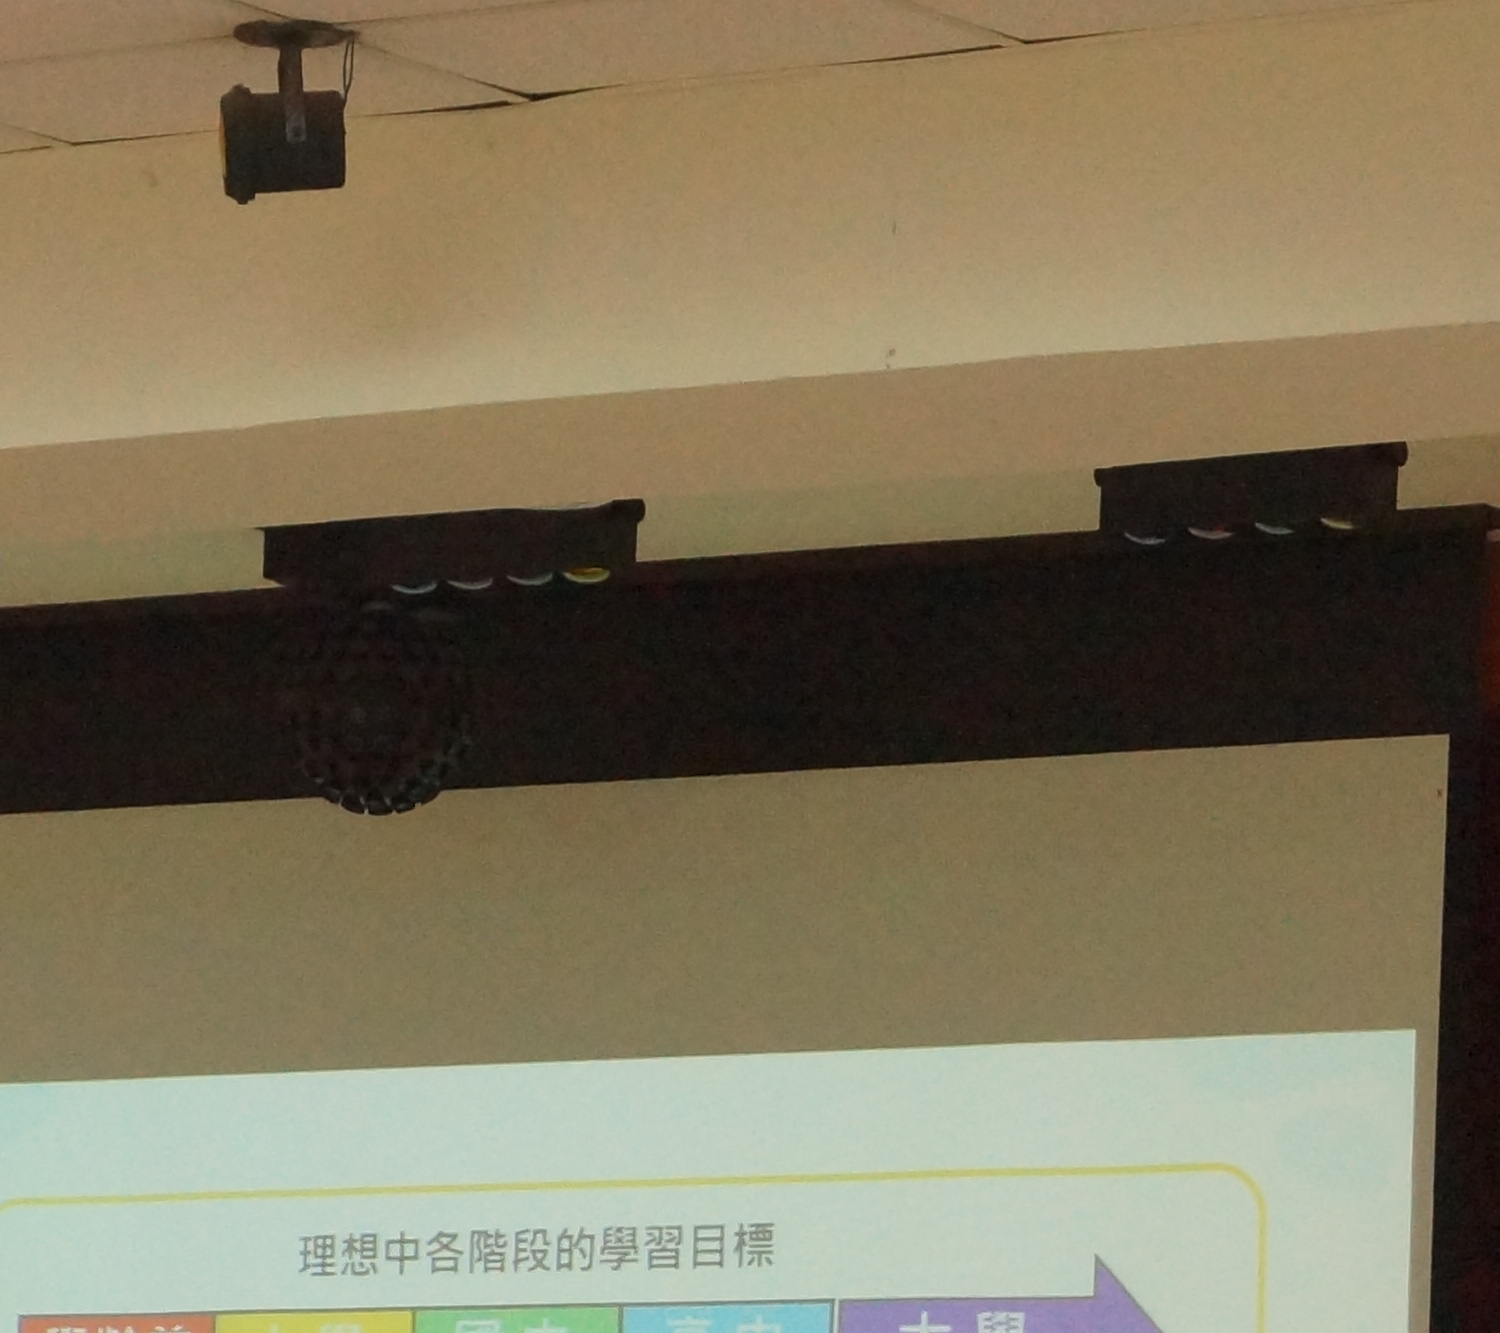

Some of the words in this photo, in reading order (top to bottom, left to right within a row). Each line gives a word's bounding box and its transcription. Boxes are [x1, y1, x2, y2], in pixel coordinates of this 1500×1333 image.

[298, 1222, 776, 1277] 理想中各階段的學習目標
